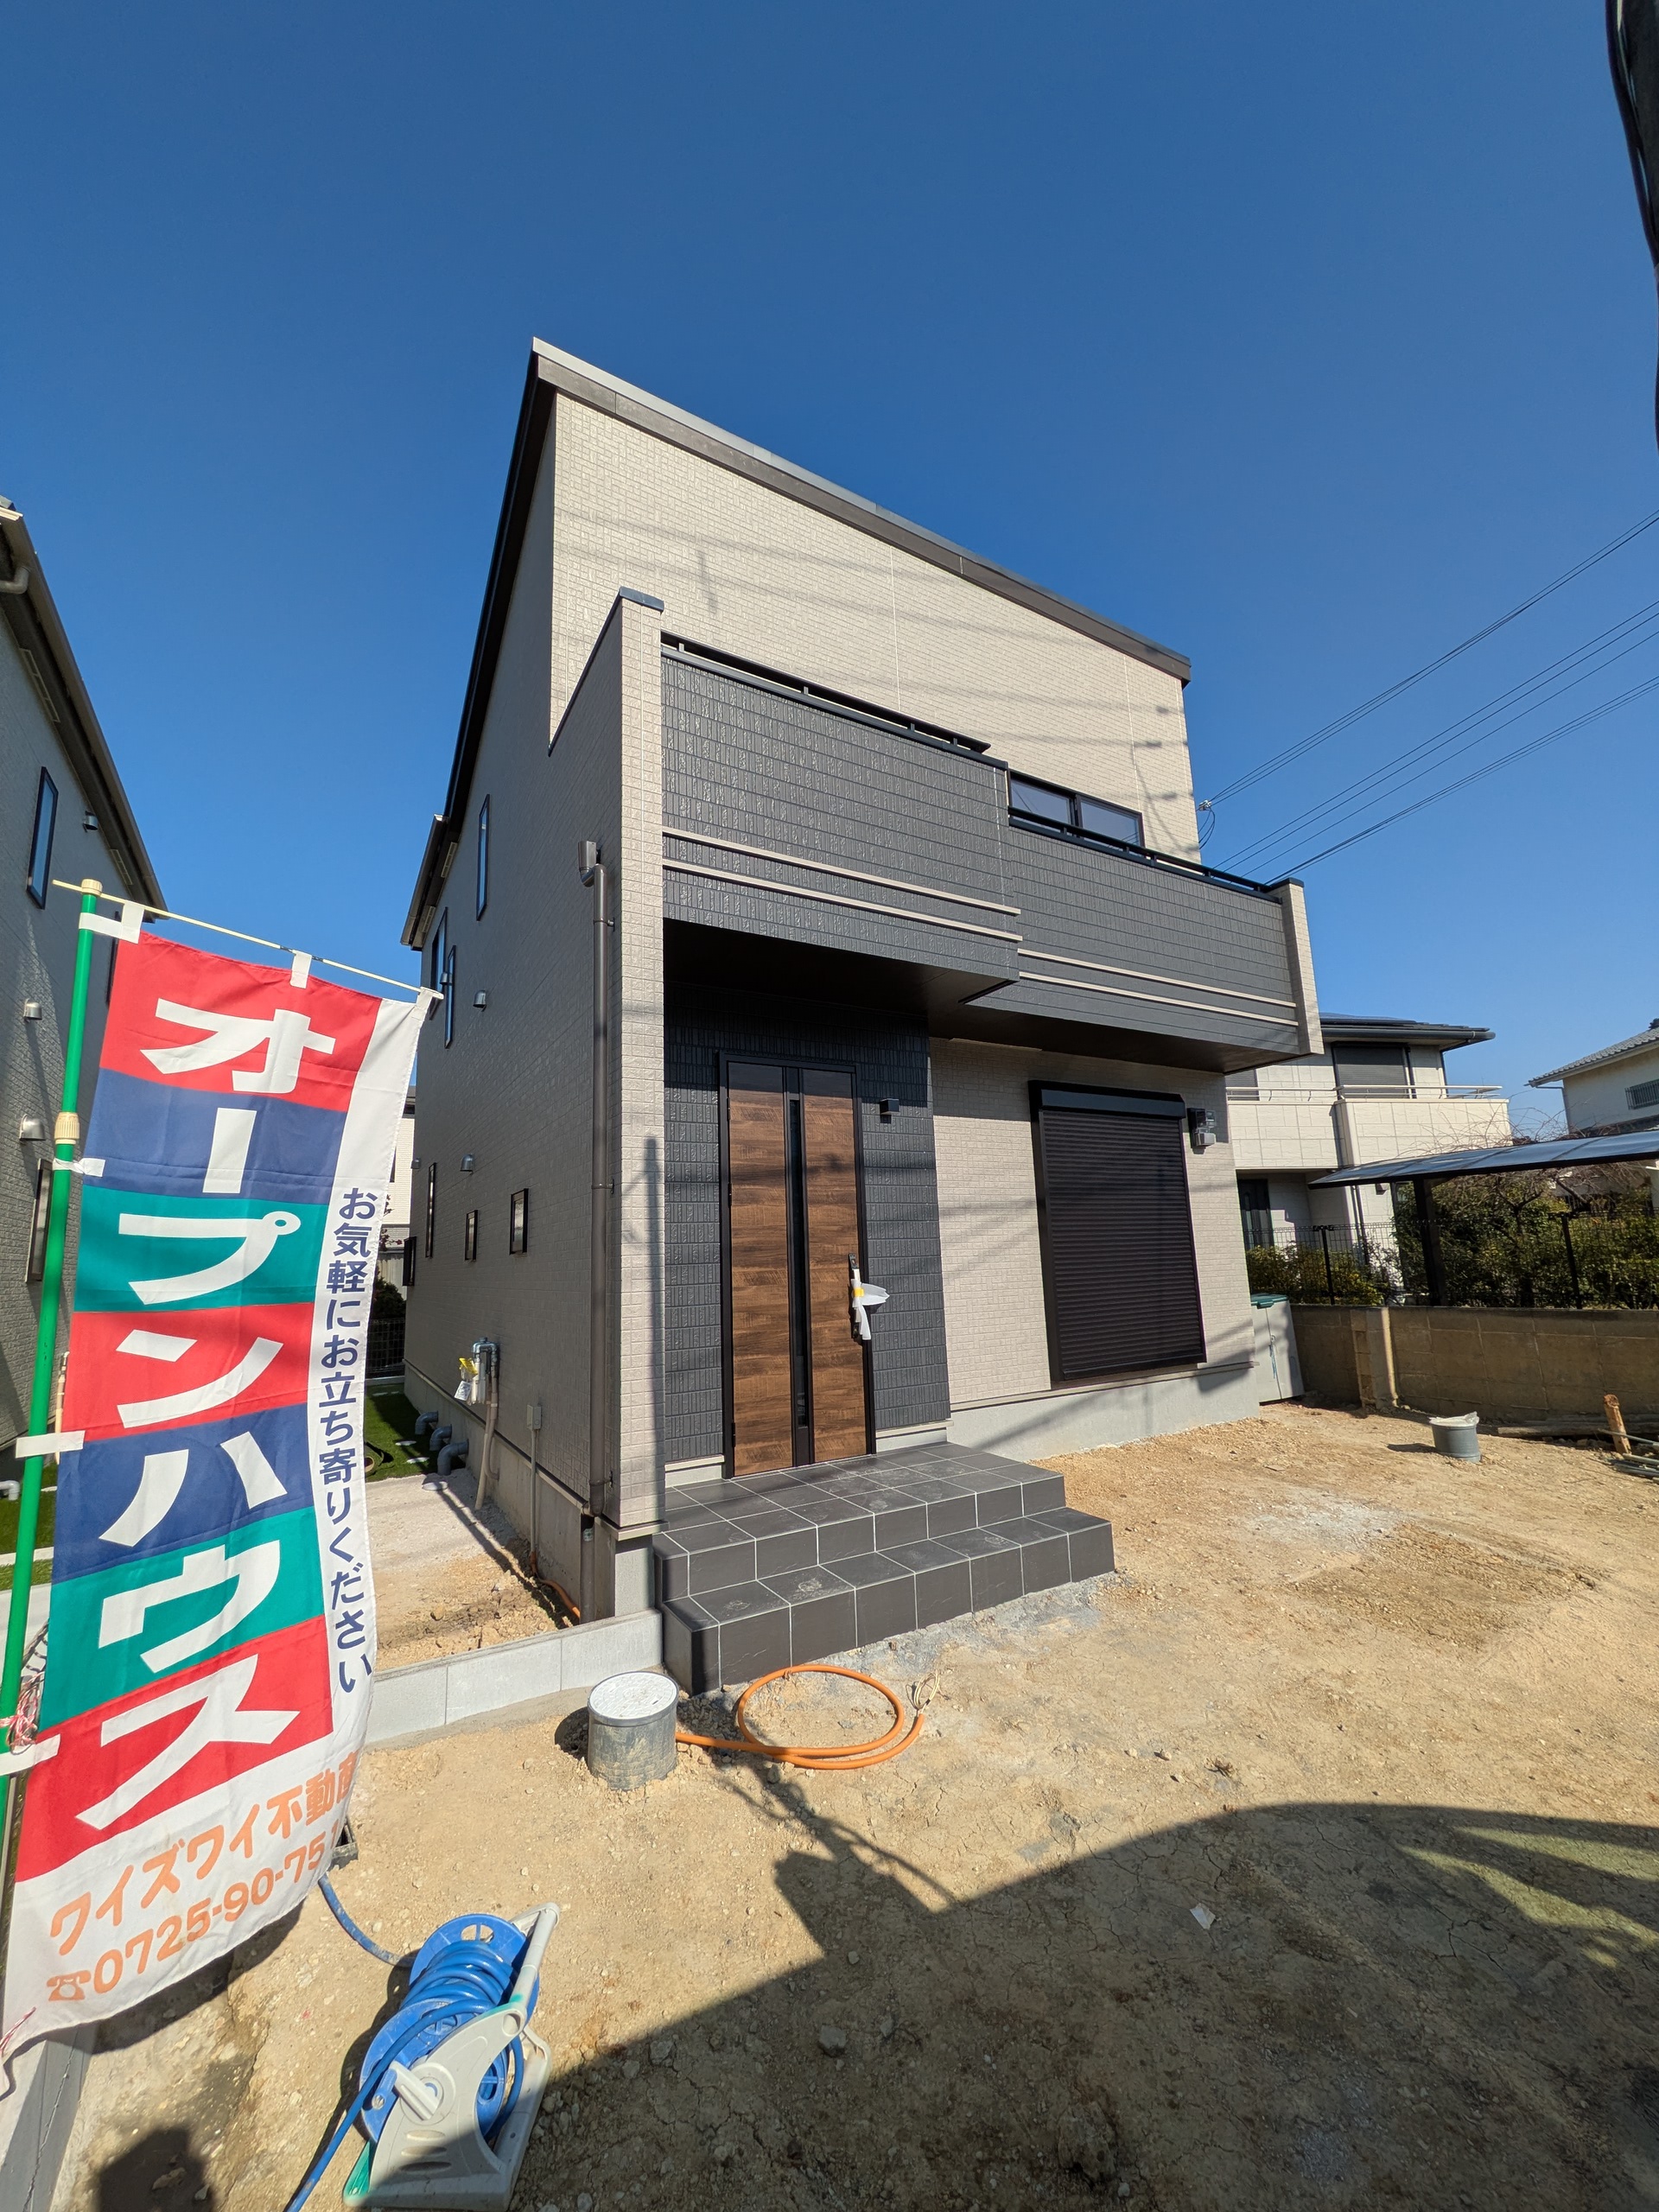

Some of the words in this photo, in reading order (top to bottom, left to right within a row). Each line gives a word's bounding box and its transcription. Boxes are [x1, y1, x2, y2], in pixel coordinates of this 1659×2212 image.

[76, 998, 335, 1830] オープンハウス
[318, 1187, 378, 1694] お気軽にお立ち寄りください
